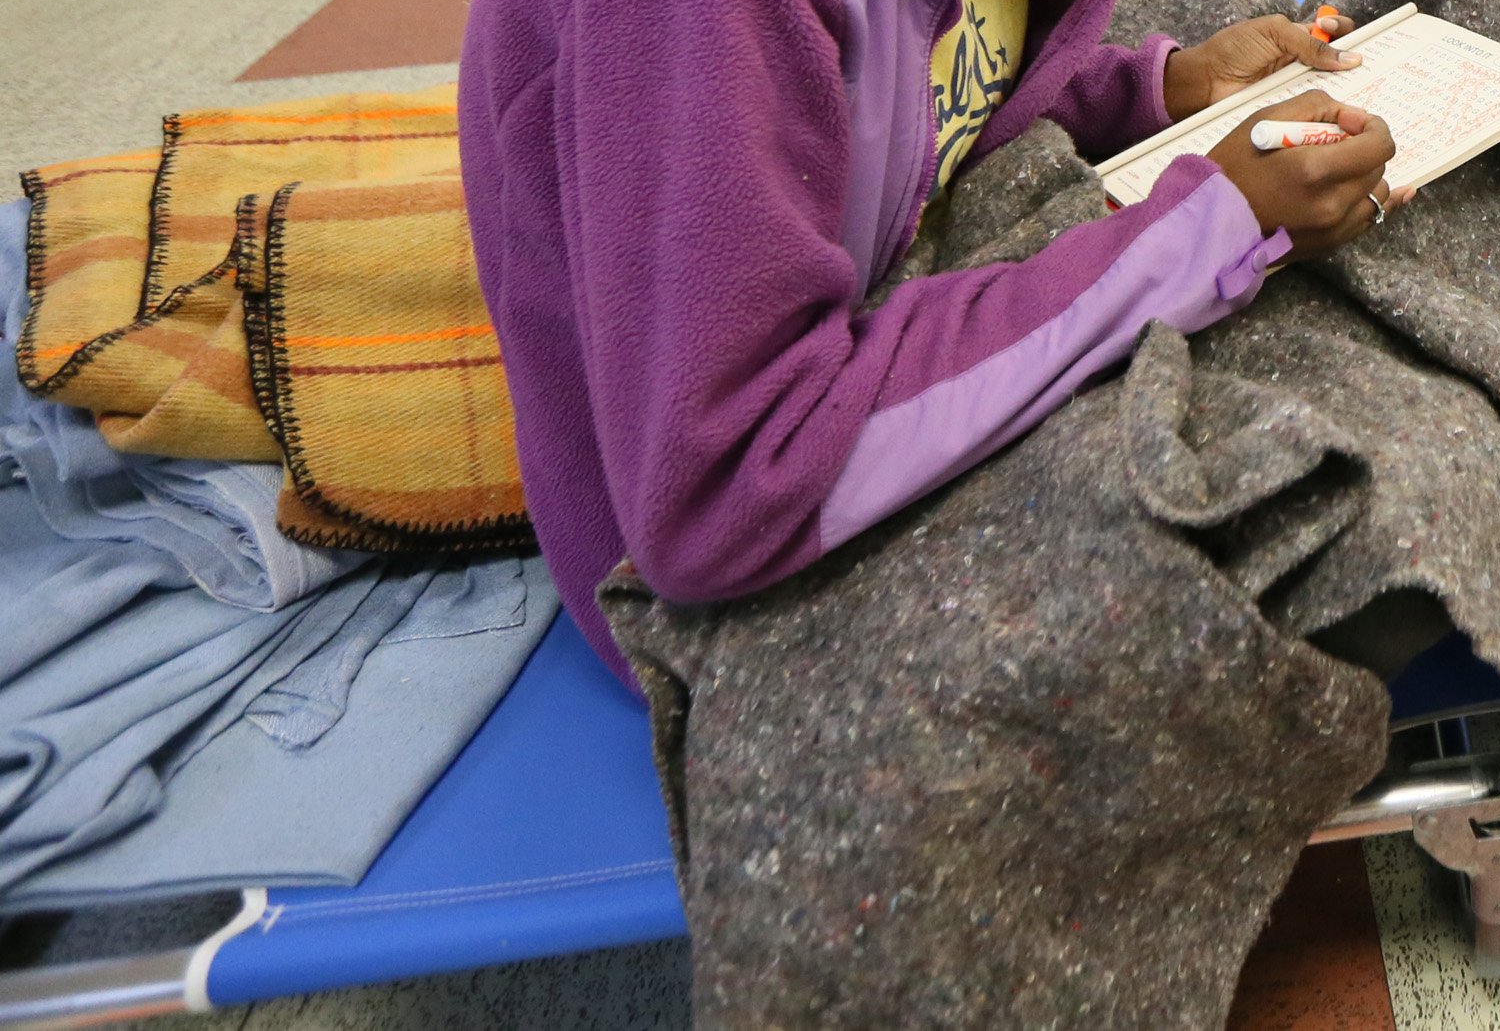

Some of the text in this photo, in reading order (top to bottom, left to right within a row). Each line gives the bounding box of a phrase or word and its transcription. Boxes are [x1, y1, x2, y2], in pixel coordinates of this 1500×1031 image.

[1441, 35, 1493, 59] LOOK INTO IT
